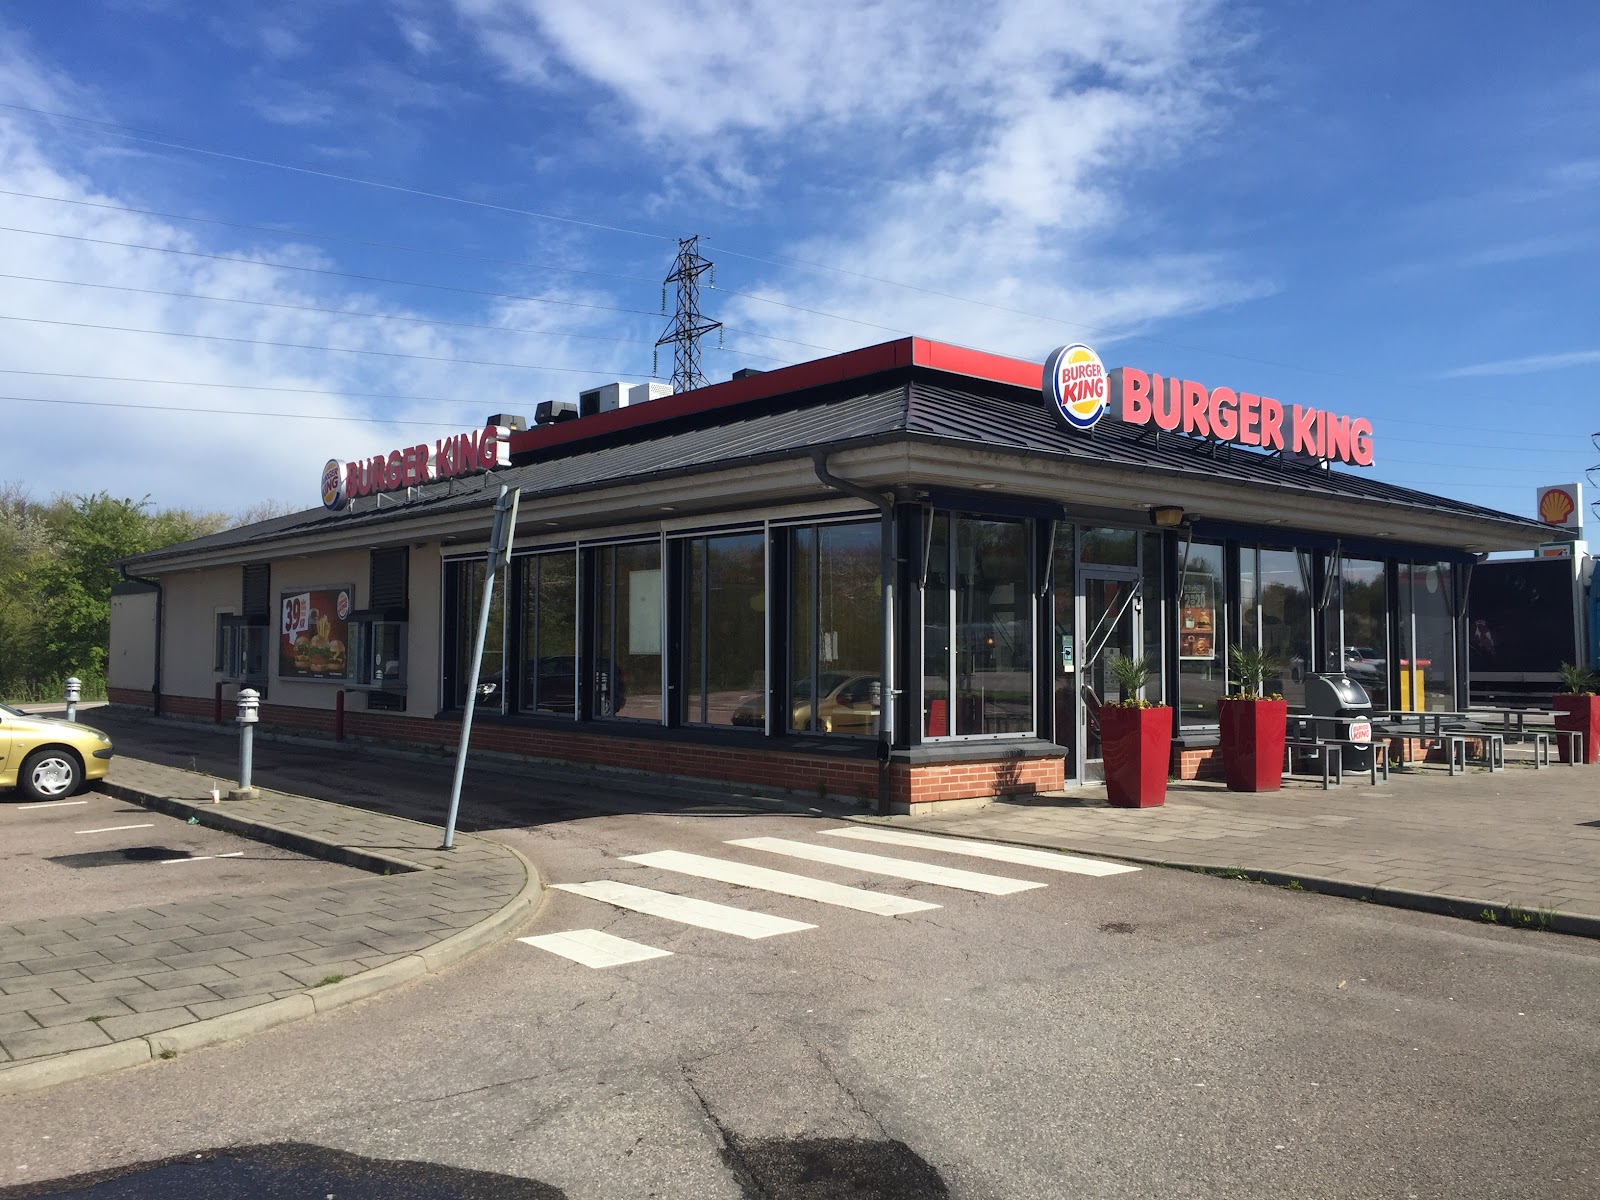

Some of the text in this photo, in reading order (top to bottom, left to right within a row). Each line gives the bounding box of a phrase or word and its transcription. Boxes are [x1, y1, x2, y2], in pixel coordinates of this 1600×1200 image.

[1062, 364, 1102, 384] BURGER
[1062, 378, 1104, 405] KING
[1121, 366, 1374, 466] BURGER KING
[345, 424, 498, 499] BURGER KING
[286, 598, 300, 631] 39
[1353, 729, 1369, 740] KING
